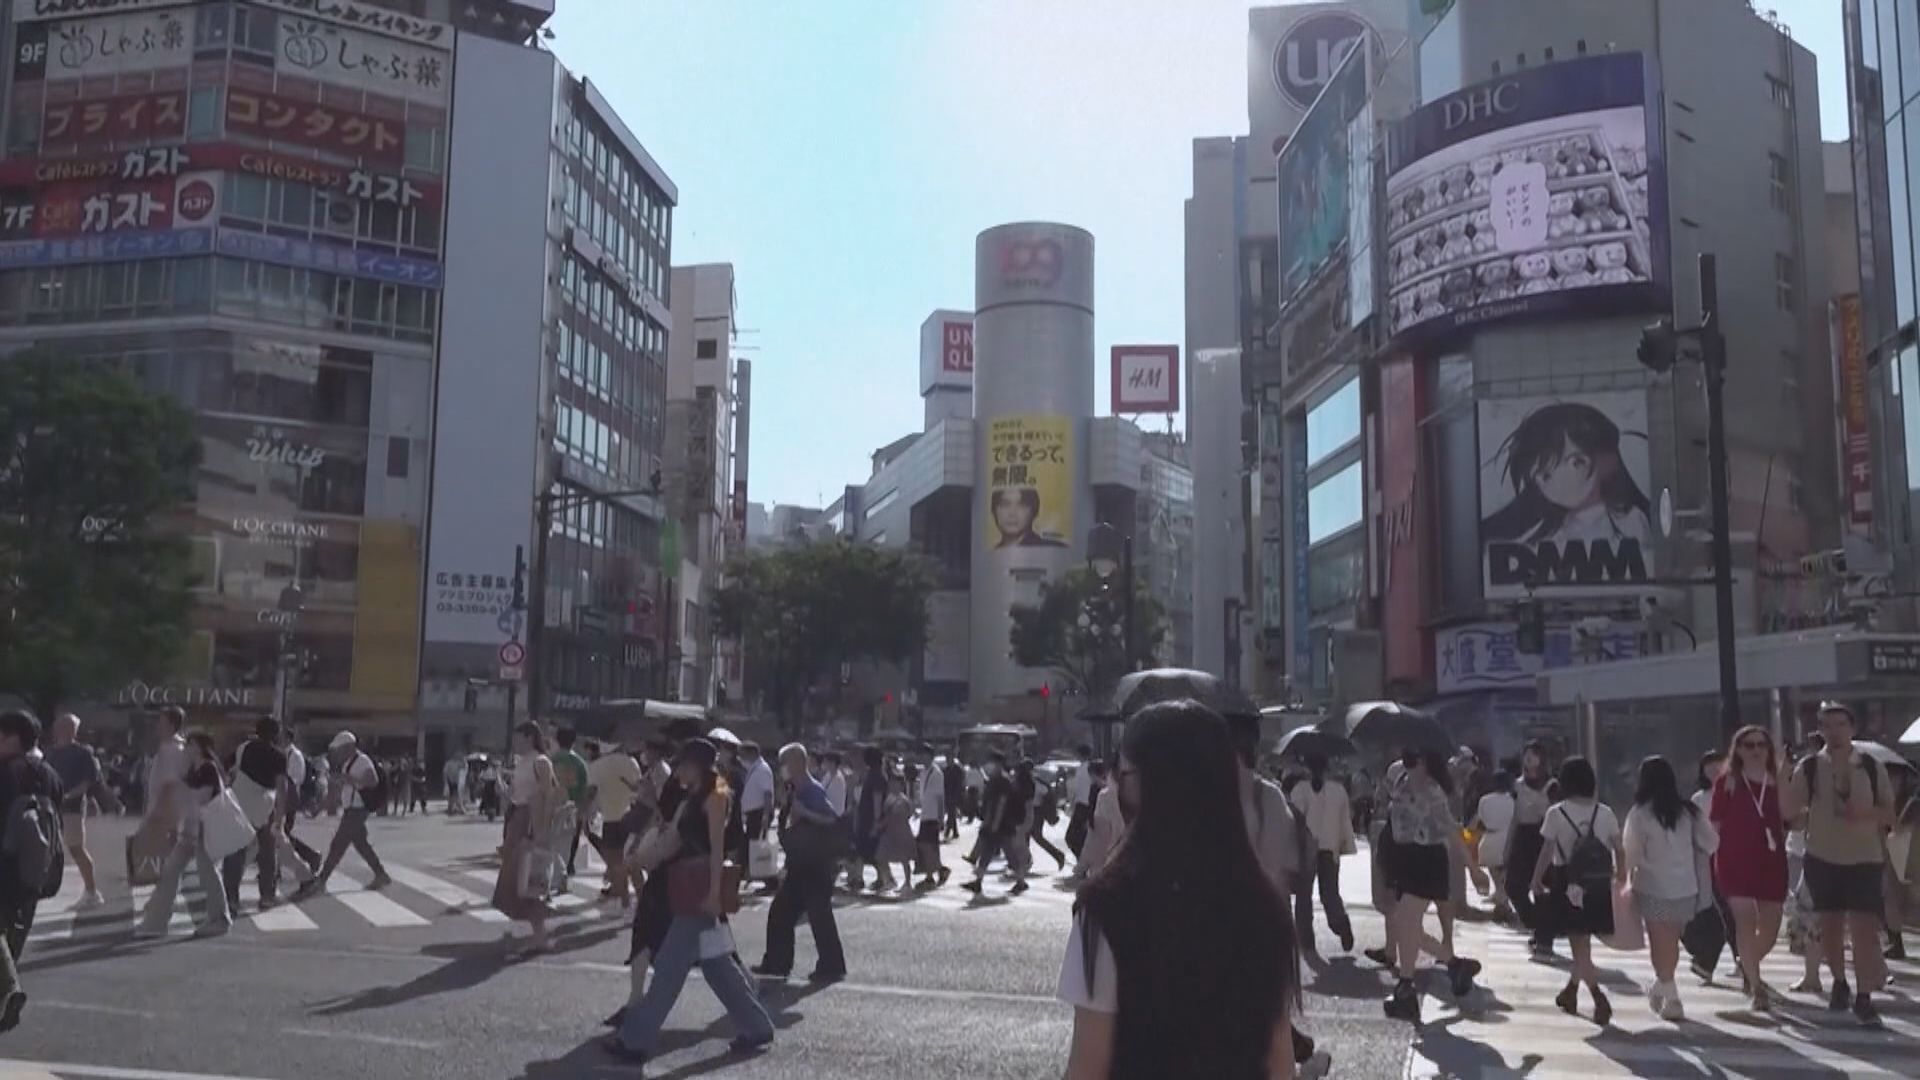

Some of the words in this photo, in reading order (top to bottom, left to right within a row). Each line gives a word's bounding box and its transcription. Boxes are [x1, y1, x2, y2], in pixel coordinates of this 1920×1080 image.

[20, 42, 46, 63] 9F
[339, 38, 442, 88] しゃぶ葉
[228, 93, 399, 150] コンタクト
[1443, 81, 1521, 130] DHC
[121, 147, 190, 179] ガスト
[346, 168, 423, 207] ガスト
[2, 204, 35, 230] 7F
[81, 191, 166, 233] ガスト
[1488, 539, 1648, 587] DMM
